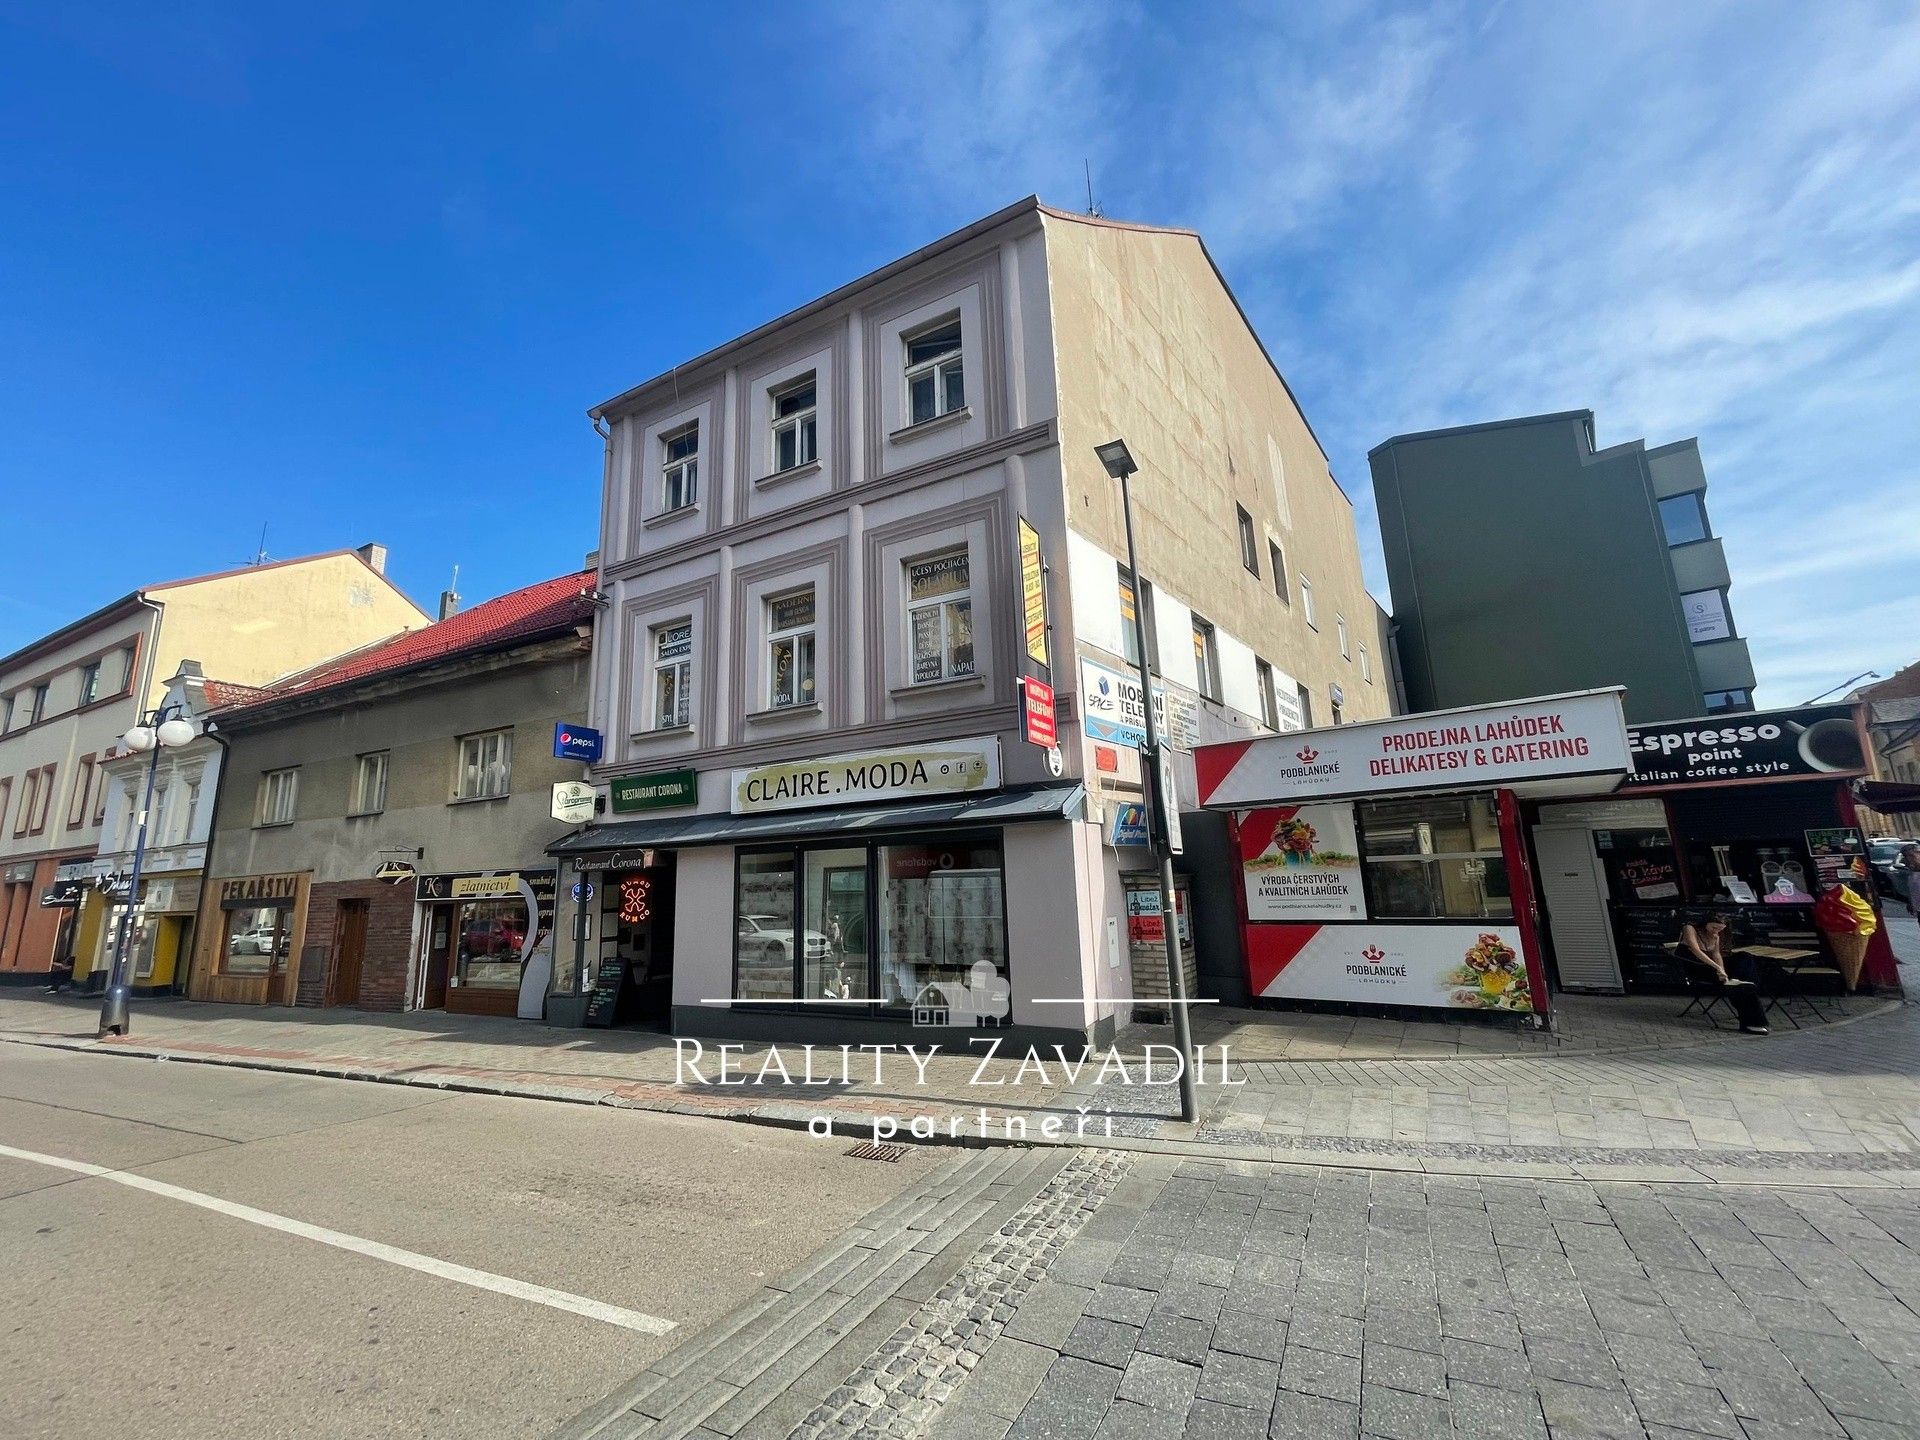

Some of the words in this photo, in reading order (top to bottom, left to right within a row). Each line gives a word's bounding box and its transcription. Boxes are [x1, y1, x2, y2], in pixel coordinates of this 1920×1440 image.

[572, 738, 594, 747] pepsi
[1382, 726, 1471, 753] PRODEJNA
[1475, 714, 1564, 743] LAHŮDEK
[1627, 723, 1781, 755] Espresso
[1369, 748, 1469, 777] DELIKATESY
[1474, 747, 1488, 766] &
[1492, 736, 1589, 764] CATERING
[1687, 747, 1743, 765] point
[1280, 760, 1340, 779] PODBLANICKÉ
[1686, 765, 1738, 777] coffee
[1746, 761, 1790, 774] style
[621, 786, 657, 801] RESTAURANT
[658, 783, 683, 796] CORONA
[574, 857, 610, 870] Restaurant
[611, 852, 641, 869] Corona
[460, 878, 511, 892] zlatnictví
[1260, 873, 1292, 886] VÝROBA
[1293, 871, 1340, 885] ČERSTVÝCH
[1258, 888, 1264, 897] A
[1265, 884, 1310, 897] KVALITNÍCH
[1311, 883, 1349, 896] LAHŮDEK
[1346, 964, 1407, 977] PODBLANICKÉ
